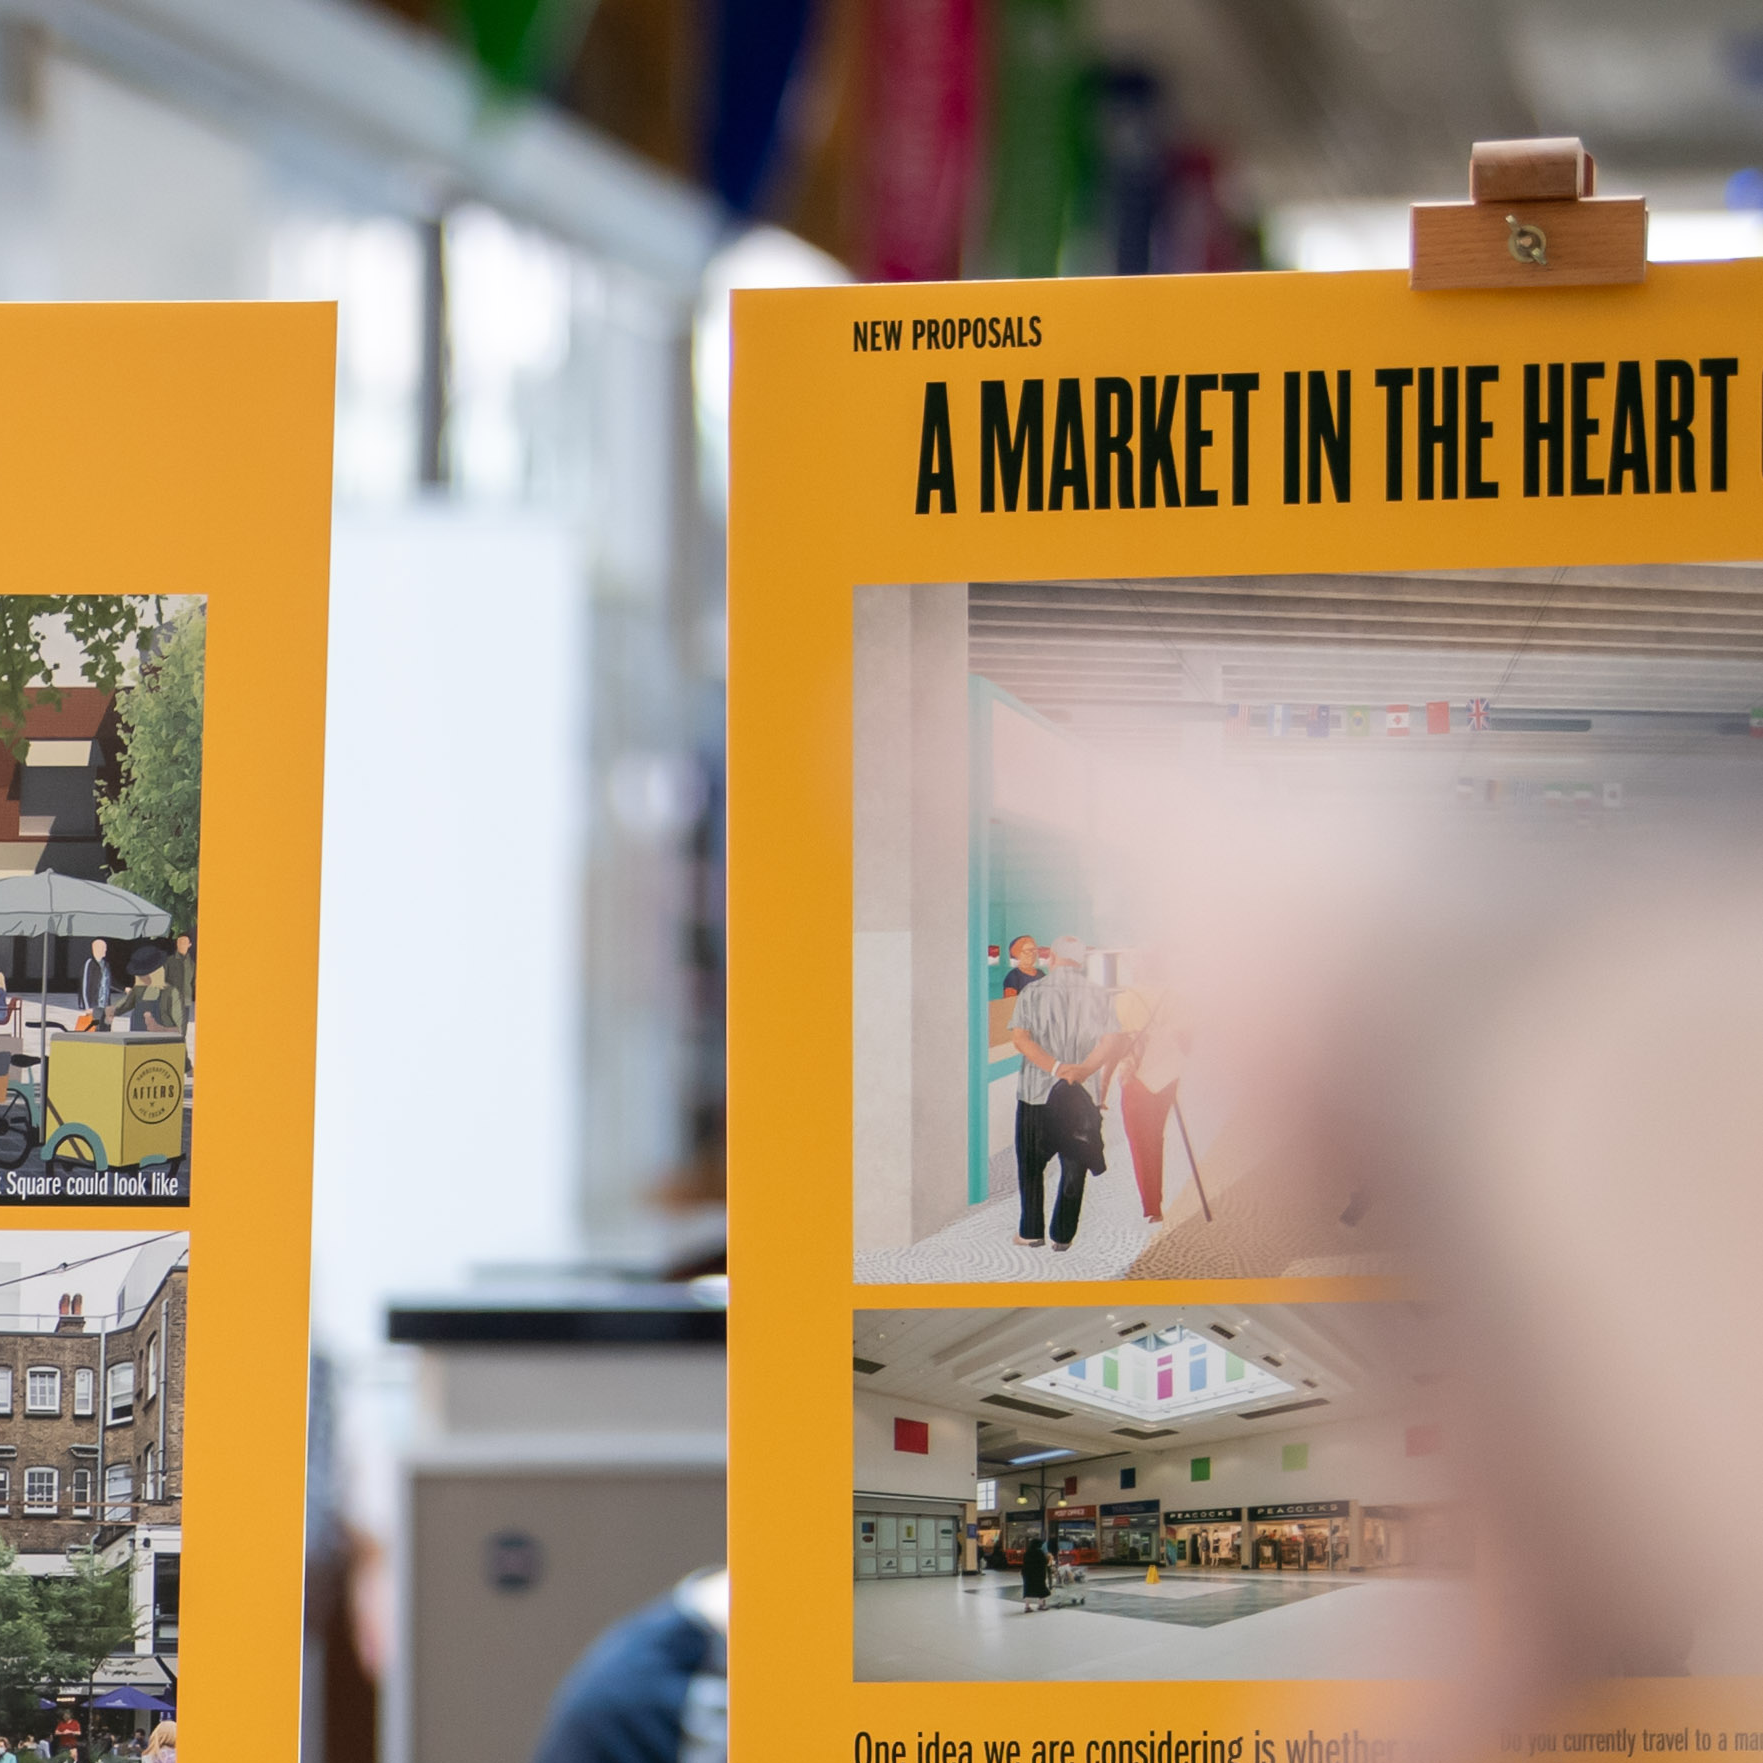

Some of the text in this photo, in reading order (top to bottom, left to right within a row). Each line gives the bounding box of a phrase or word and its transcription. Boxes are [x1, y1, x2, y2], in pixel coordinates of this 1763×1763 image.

[853, 315, 1042, 352] NEW PROPOSALS
[915, 357, 1738, 515] A MARKET IN THE HEART
[133, 1085, 175, 1100] AFTERS
[6, 1171, 61, 1200] Square
[66, 1169, 108, 1194] could
[113, 1169, 146, 1195] look
[151, 1171, 179, 1196] like
[1168, 1509, 1233, 1520] PEACOCKS
[1257, 1502, 1339, 1516] PEACOCKS
